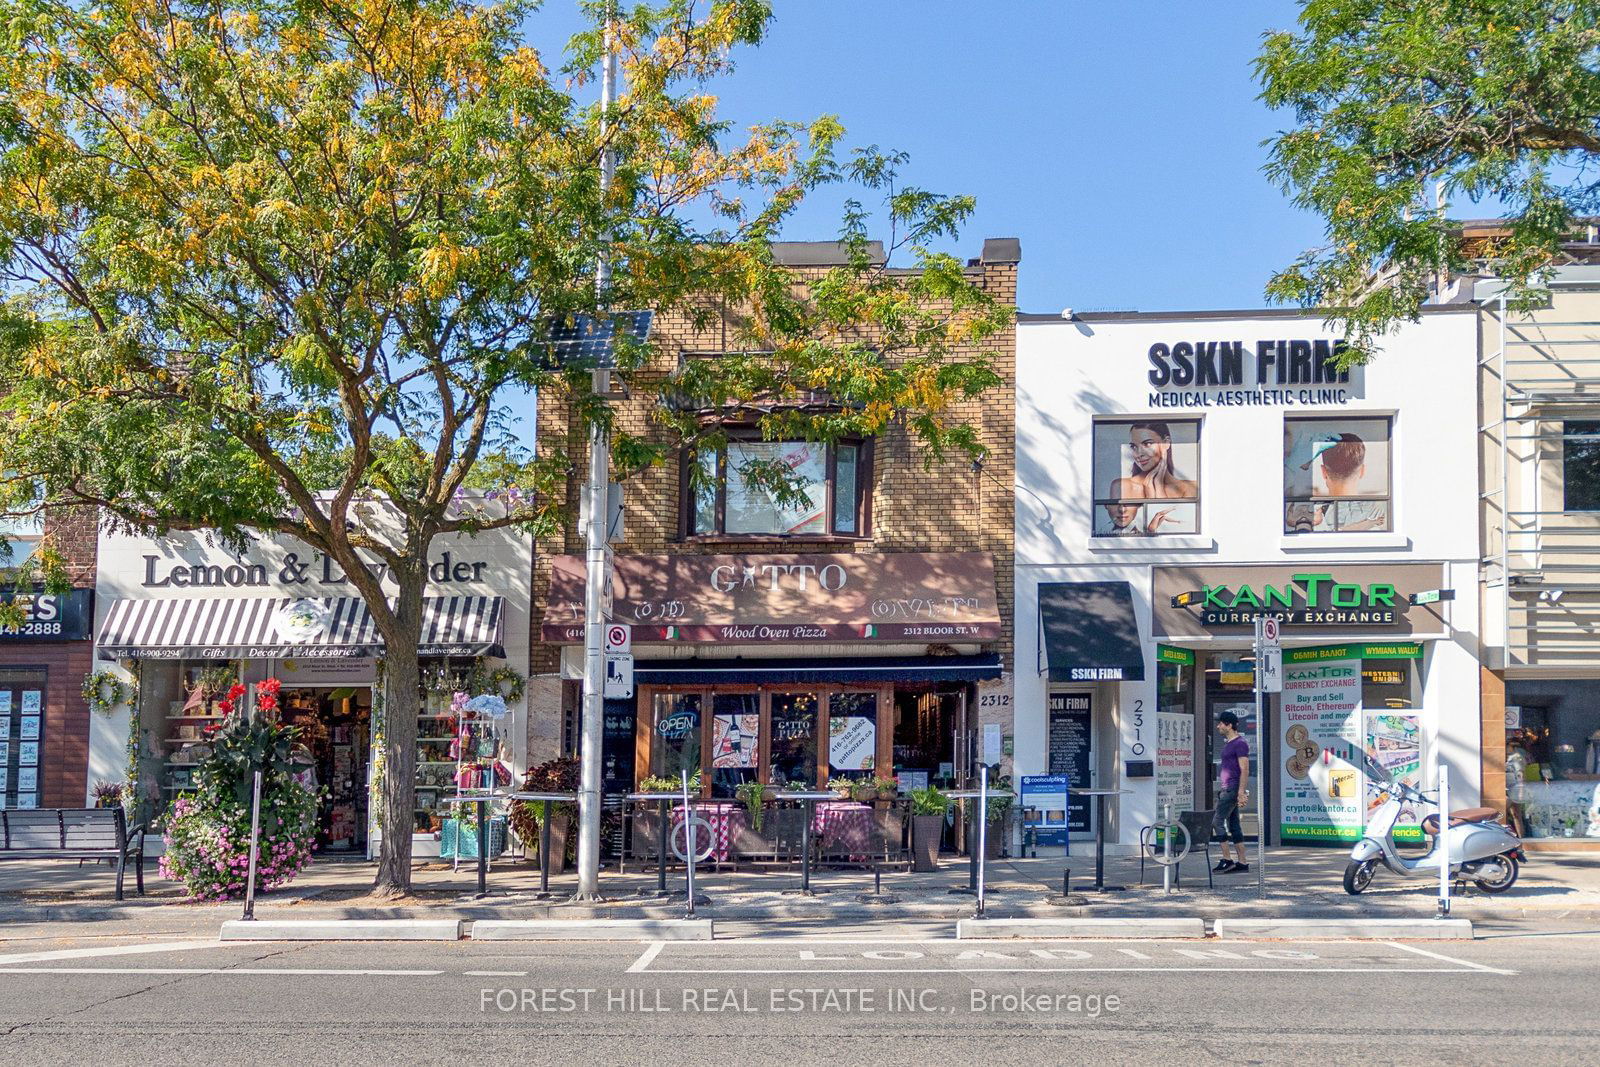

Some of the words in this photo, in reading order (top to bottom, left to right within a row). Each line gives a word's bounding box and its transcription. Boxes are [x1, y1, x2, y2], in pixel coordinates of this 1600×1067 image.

[1148, 341, 1243, 387] SSKN
[1149, 392, 1212, 407] MEDICAL
[1217, 390, 1294, 406] AESTHETIC
[1300, 389, 1348, 404] CLINIC
[142, 555, 270, 588] Lemon
[278, 553, 309, 585] &
[1202, 574, 1396, 608] KANTOR
[1208, 612, 1295, 623] CURRENCY
[1305, 612, 1393, 623] EXCHANGE
[722, 626, 758, 638] Wood
[759, 626, 789, 638] Oven
[792, 626, 827, 638] Pizza
[903, 627, 921, 635] 2312
[923, 627, 954, 635] BLOOR
[955, 626, 968, 634] ST.
[970, 626, 980, 634] W
[117, 649, 129, 657] Tel.
[131, 649, 180, 658] 416-900-9294
[202, 648, 225, 658] Gifts
[249, 648, 279, 658] Decor
[301, 647, 357, 657] Accessories
[1366, 646, 1396, 655] WYMIANA
[1072, 668, 1097, 679] SSKN
[1099, 668, 1122, 679] FIRM
[1288, 666, 1352, 680] KANTOR
[1285, 680, 1319, 690] CURRENCY
[1321, 679, 1356, 688] EXCHANGE
[981, 695, 1009, 706] 2312
[1297, 694, 1310, 703] Buy
[1312, 693, 1327, 702] and
[1329, 692, 1344, 701] Sell
[1067, 698, 1088, 710] FIRM
[1285, 703, 1314, 712] Bitcoin,
[1288, 712, 1318, 721] Litecoin
[1320, 711, 1335, 719] and
[659, 716, 693, 732] OPEN
[1132, 700, 1145, 755] 2310
[779, 730, 810, 738] PIZZA
[838, 730, 873, 765] gattopizza.ca
[1286, 804, 1357, 814] crypto@kantor.ca
[1286, 826, 1357, 838] www.kantor.ca
[800, 949, 1319, 961] LOADING
